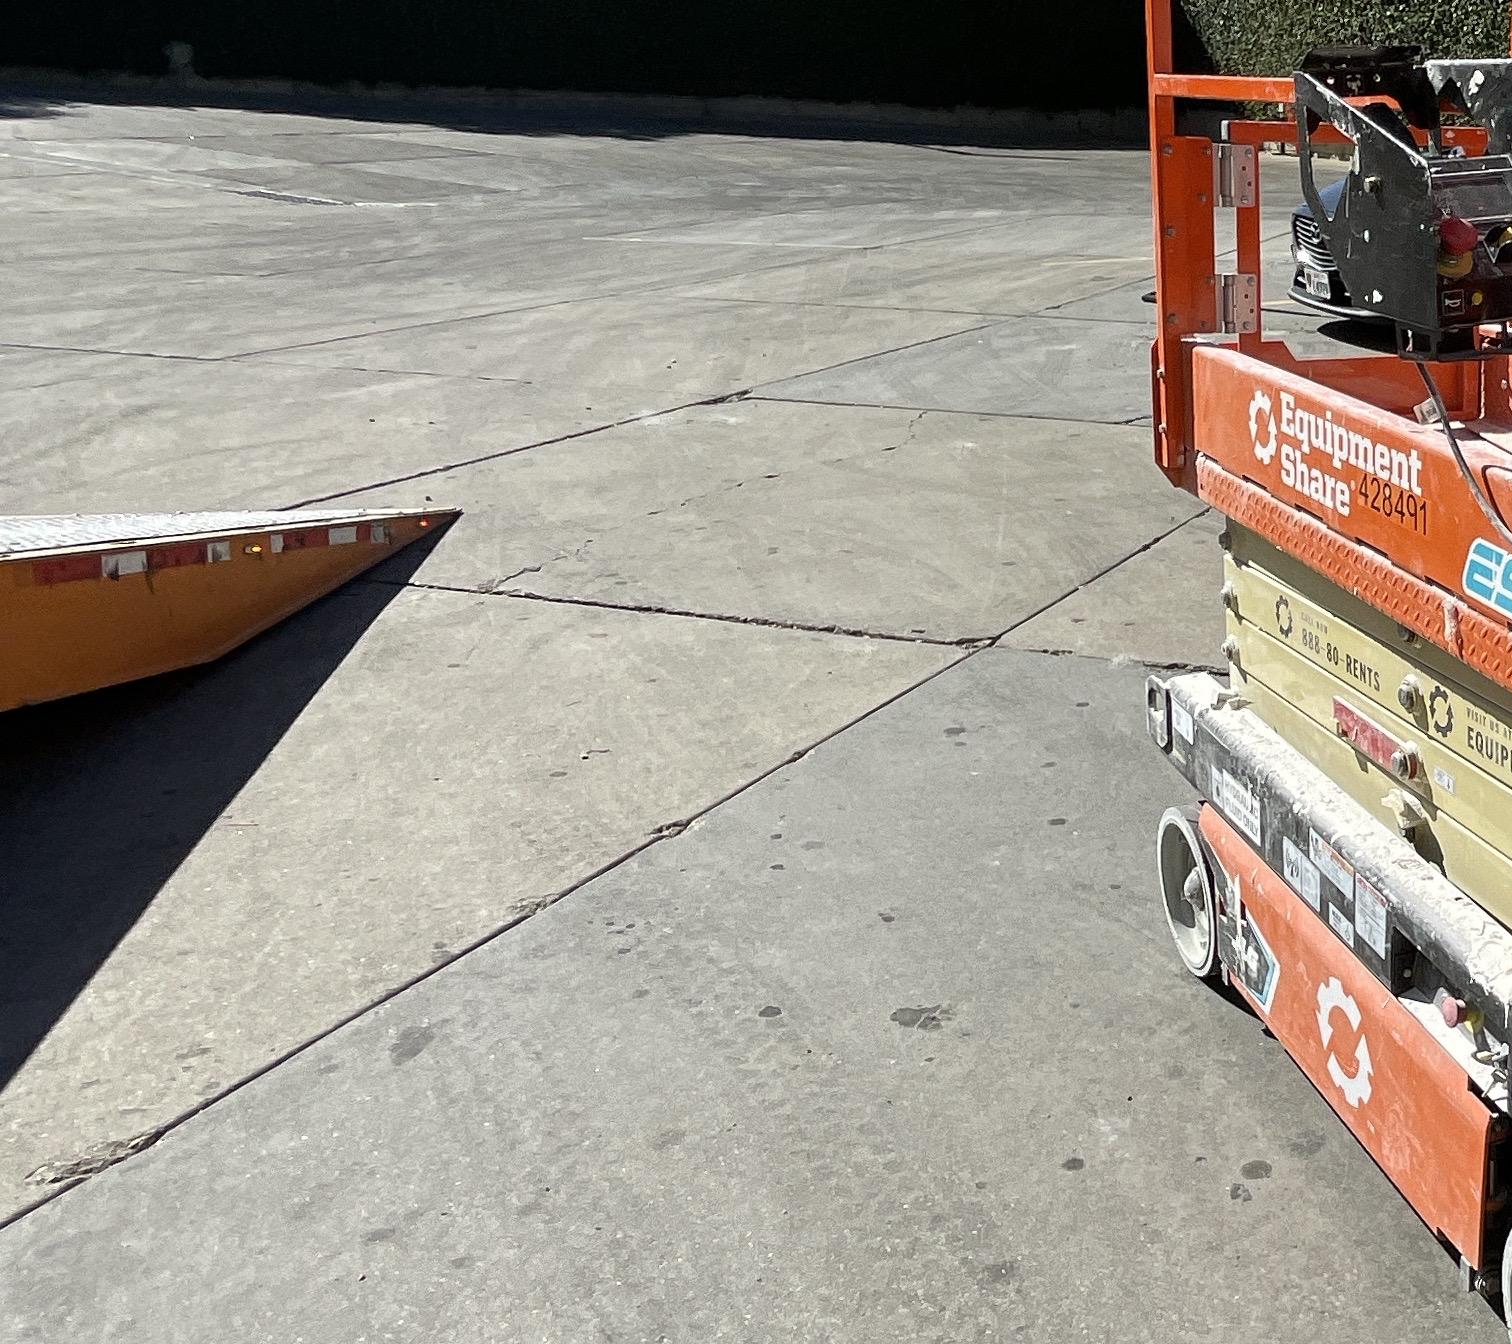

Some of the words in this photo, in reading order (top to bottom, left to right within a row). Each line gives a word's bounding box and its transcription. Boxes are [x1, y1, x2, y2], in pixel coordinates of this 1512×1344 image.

[1279, 390, 1422, 497] Equipment
[1280, 442, 1350, 518] Share
[1358, 473, 1428, 536] 428491
[1302, 627, 1381, 692] 888-80-RENTS
